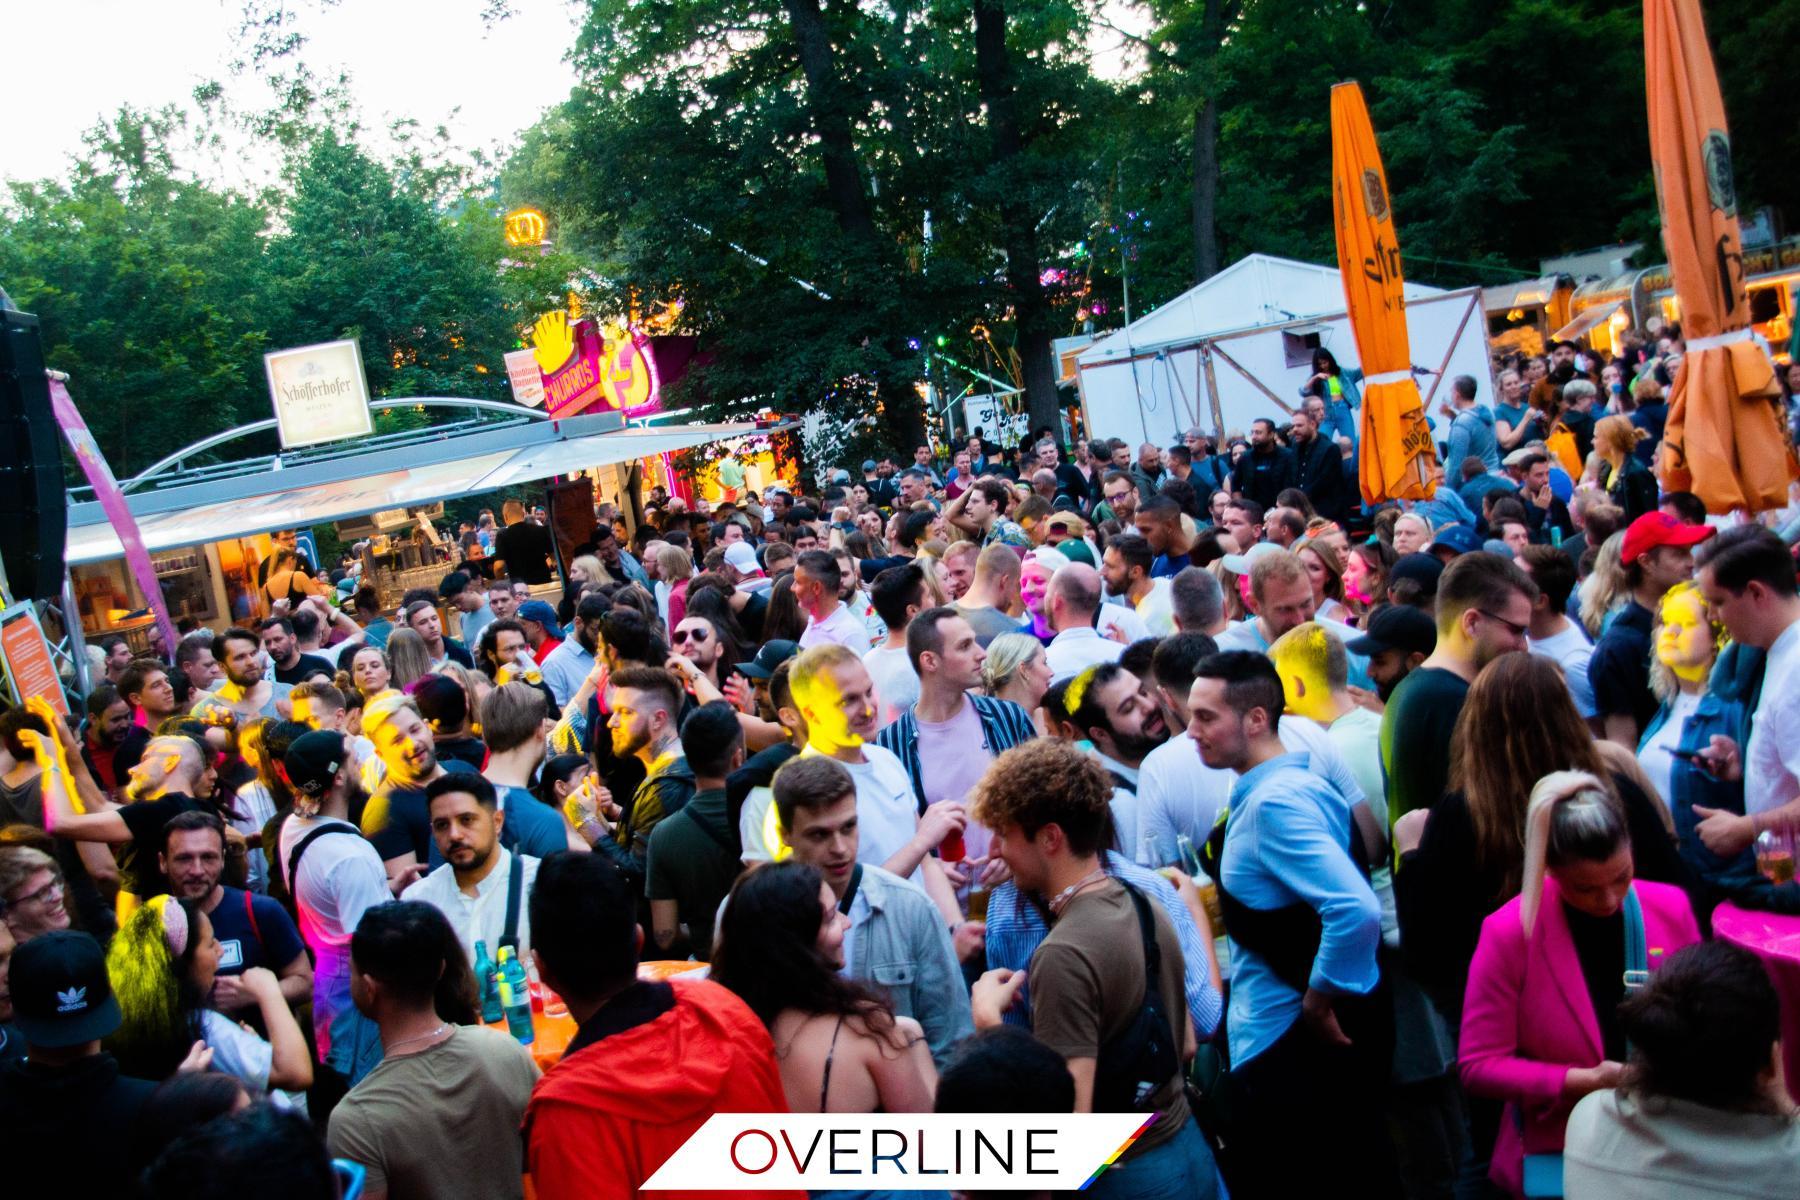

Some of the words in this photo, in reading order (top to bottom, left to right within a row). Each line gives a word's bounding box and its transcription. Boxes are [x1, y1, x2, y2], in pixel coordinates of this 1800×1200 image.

[282, 377, 351, 406] Schöfferhofer
[544, 359, 594, 410] CHURROS
[57, 1001, 87, 1011] adidas
